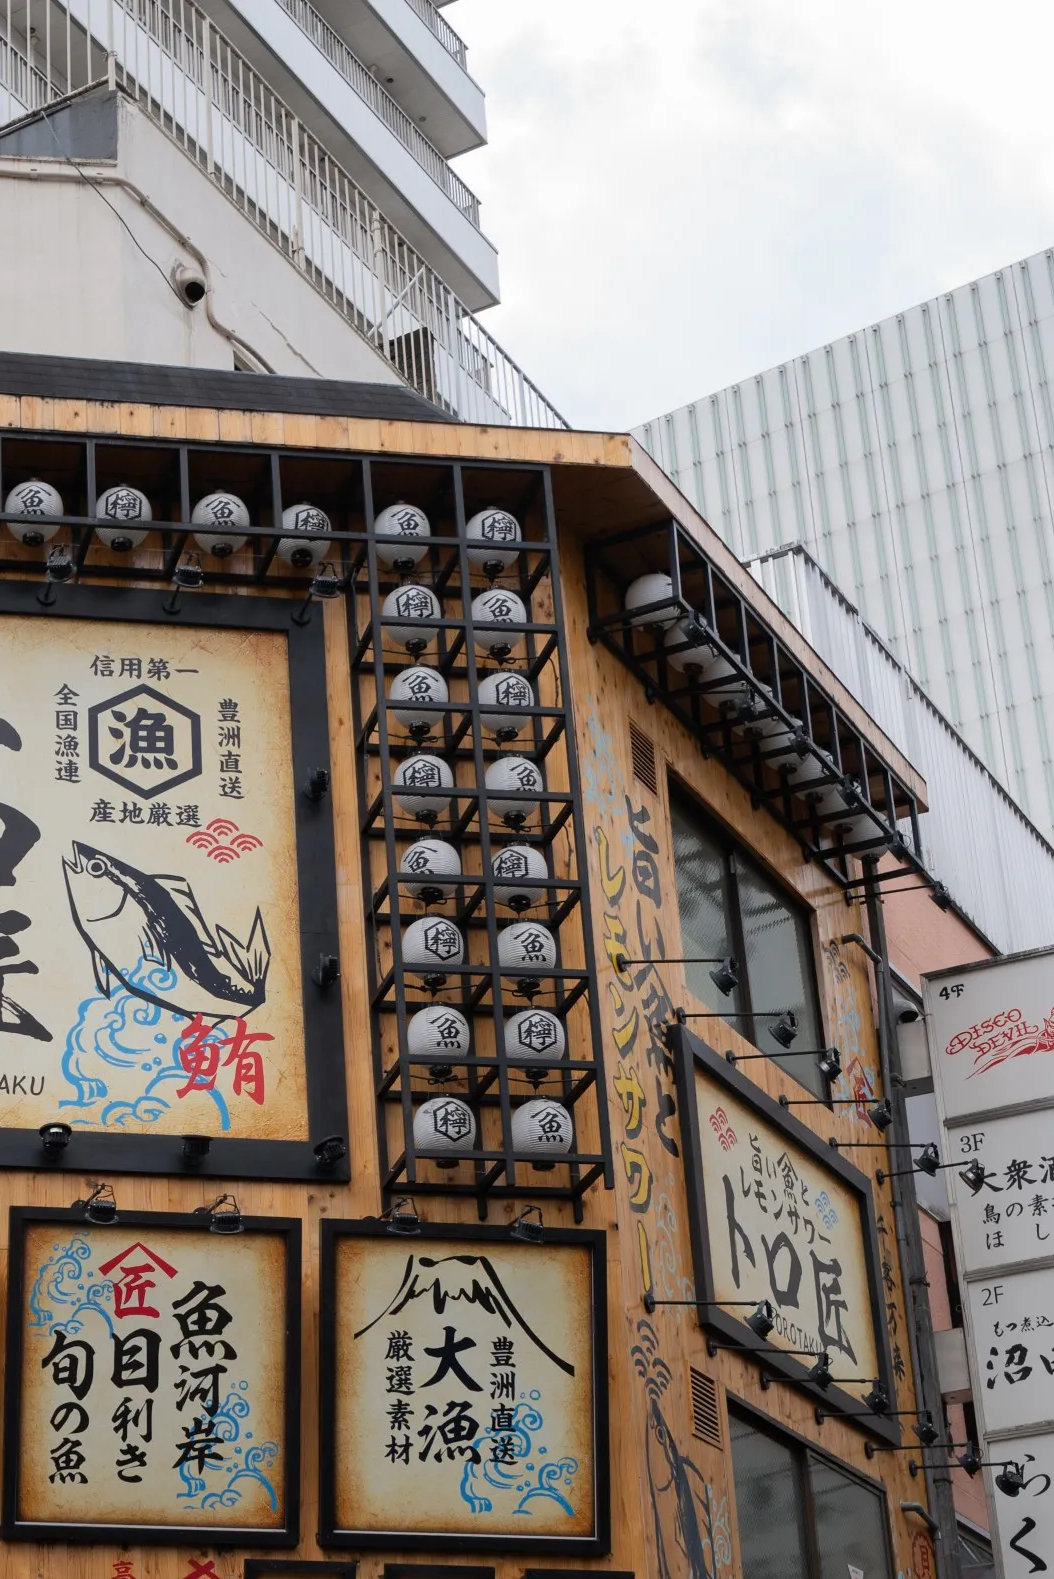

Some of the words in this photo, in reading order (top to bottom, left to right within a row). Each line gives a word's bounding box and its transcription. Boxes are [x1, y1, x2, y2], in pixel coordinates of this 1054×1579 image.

[89, 655, 199, 679] 信用第一
[55, 683, 82, 784] 全国漁連
[109, 709, 178, 770] 漁
[216, 698, 245, 799] 豊洲直送
[89, 798, 203, 828] 産地厳選
[939, 984, 965, 1001] 4F
[945, 1008, 1022, 1056] DISCO
[176, 1013, 275, 1106] 鮪
[594, 826, 654, 1293] レモンサワー
[968, 1019, 1041, 1060] DEVIL
[959, 1133, 985, 1154] 3F
[740, 1166, 831, 1245] レモンサワー
[111, 1262, 161, 1320] 匠
[722, 1174, 858, 1366] トロ匠
[982, 1285, 1004, 1307] 2F
[42, 1329, 96, 1485] 旬の魚
[110, 1328, 163, 1483] 目利き
[170, 1281, 238, 1473] 魚河岸
[384, 1330, 416, 1465] 厳選素材
[418, 1326, 484, 1465] 大漁
[489, 1336, 517, 1466] 豊洲直送
